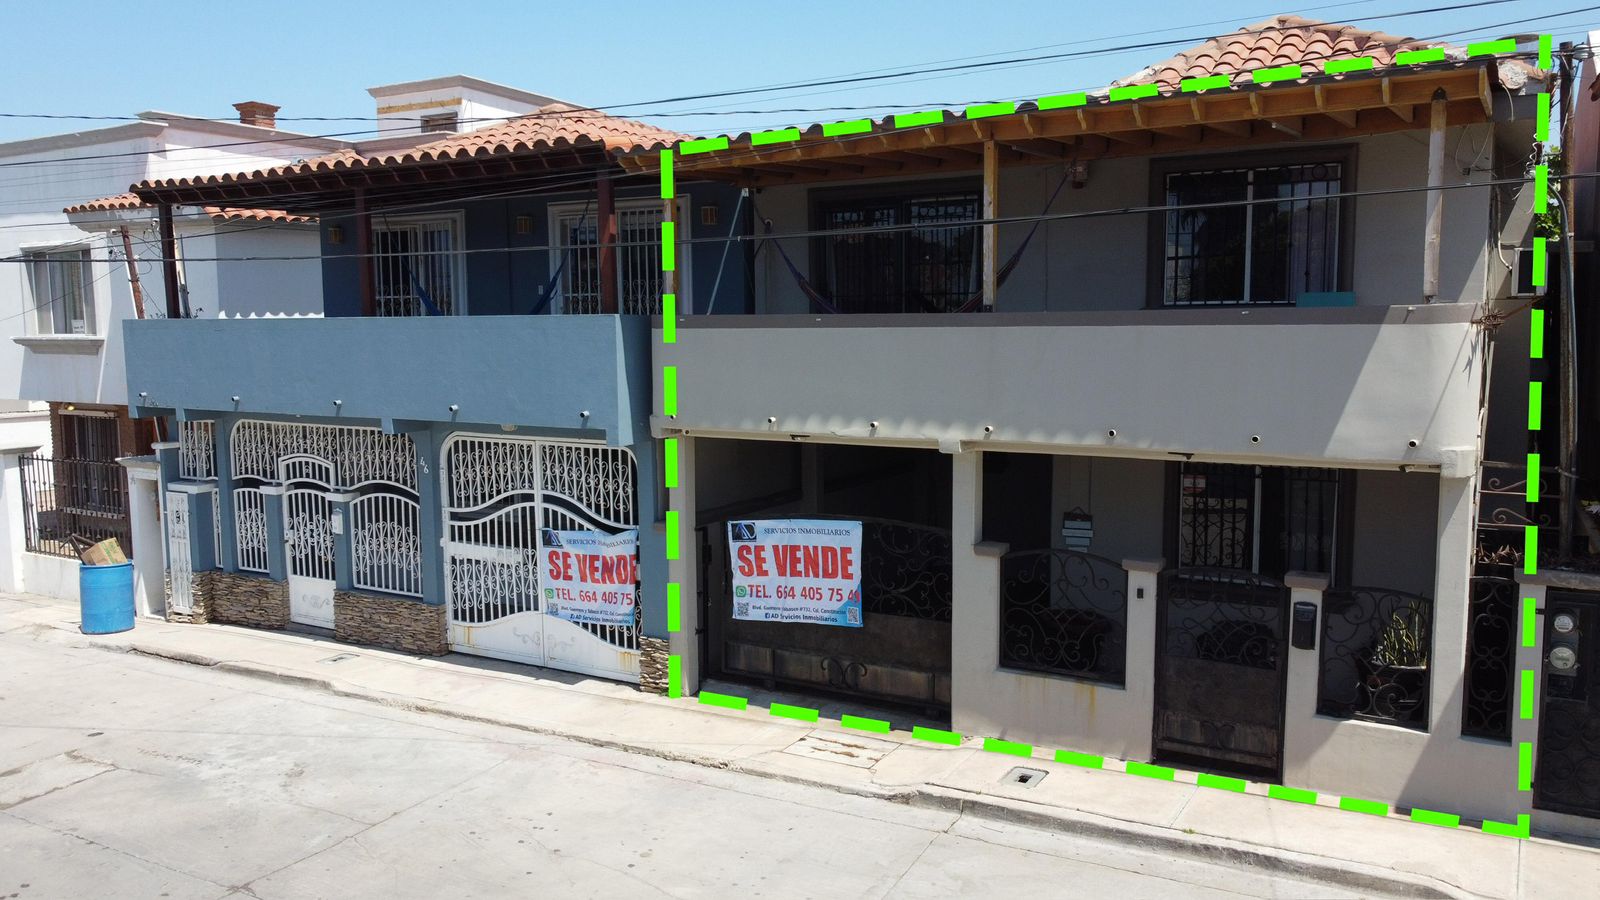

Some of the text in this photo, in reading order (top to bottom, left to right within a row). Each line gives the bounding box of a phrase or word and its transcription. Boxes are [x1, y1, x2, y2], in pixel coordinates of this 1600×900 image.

[420, 456, 429, 474] 46
[798, 528, 850, 536] INMOBILIARIOS
[548, 550, 572, 580] SE
[737, 544, 854, 580] SE VENDE
[556, 588, 633, 606] TEL. 664 405 75
[748, 584, 772, 598] TEL.
[776, 585, 796, 599] 664
[800, 586, 822, 601] 405
[828, 588, 844, 602] 75
[803, 614, 838, 622] Inmobiliarios
